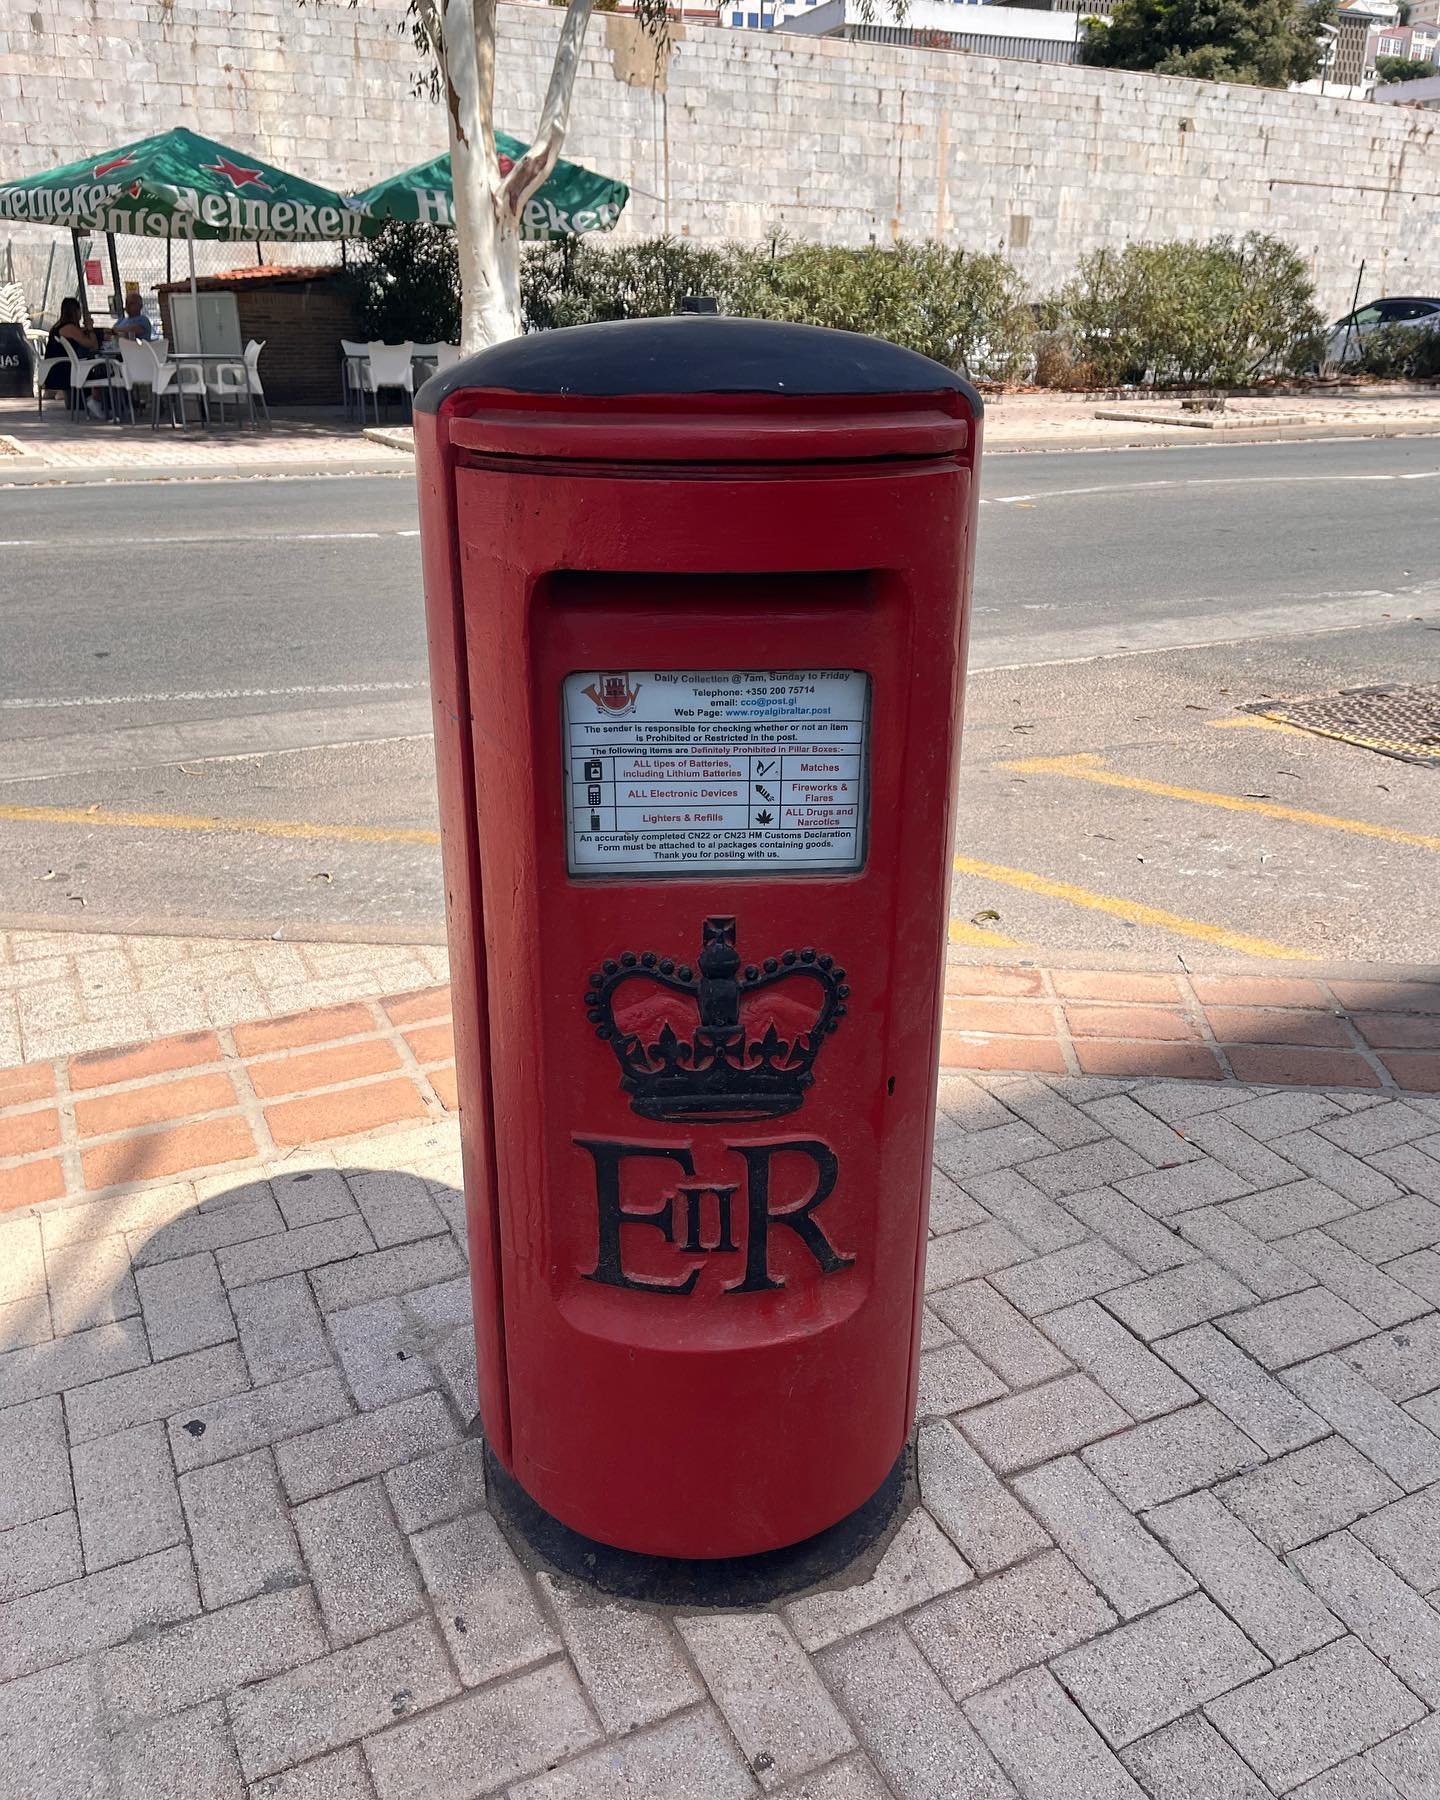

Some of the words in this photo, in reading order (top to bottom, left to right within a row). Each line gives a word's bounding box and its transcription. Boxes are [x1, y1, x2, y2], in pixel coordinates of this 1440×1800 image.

[164, 185, 362, 236] Heineken
[654, 674, 678, 684] Daily
[682, 674, 730, 683] Collection
[732, 674, 742, 684] @
[744, 674, 766, 682] 7am,
[769, 672, 806, 682] Sunday
[808, 672, 818, 680] to
[820, 672, 850, 681] Friday
[692, 688, 743, 698] Telephone:
[746, 688, 768, 696] +350
[770, 687, 786, 695] 200
[788, 686, 815, 694] 75714
[740, 697, 796, 707] cco@post.gi
[697, 708, 723, 718] Page:
[726, 706, 831, 717] www.royalgibraltar.post
[584, 726, 600, 734] The
[644, 725, 696, 734] responsible
[712, 725, 752, 734] checking
[776, 734, 798, 742] post.
[608, 746, 648, 755] following
[690, 746, 730, 754] Definitely
[654, 760, 676, 768] tipes
[690, 760, 732, 768] Batteries,
[624, 770, 664, 778] including
[792, 784, 838, 792] Fireworks
[806, 809, 834, 818] Drugs
[642, 814, 681, 824] Lighters
[594, 834, 639, 842] accurately
[642, 833, 686, 842] completed
[718, 841, 757, 850] packages
[760, 841, 803, 850] containing
[806, 840, 834, 850] goods.
[682, 852, 698, 860] you
[714, 851, 745, 860] posting
